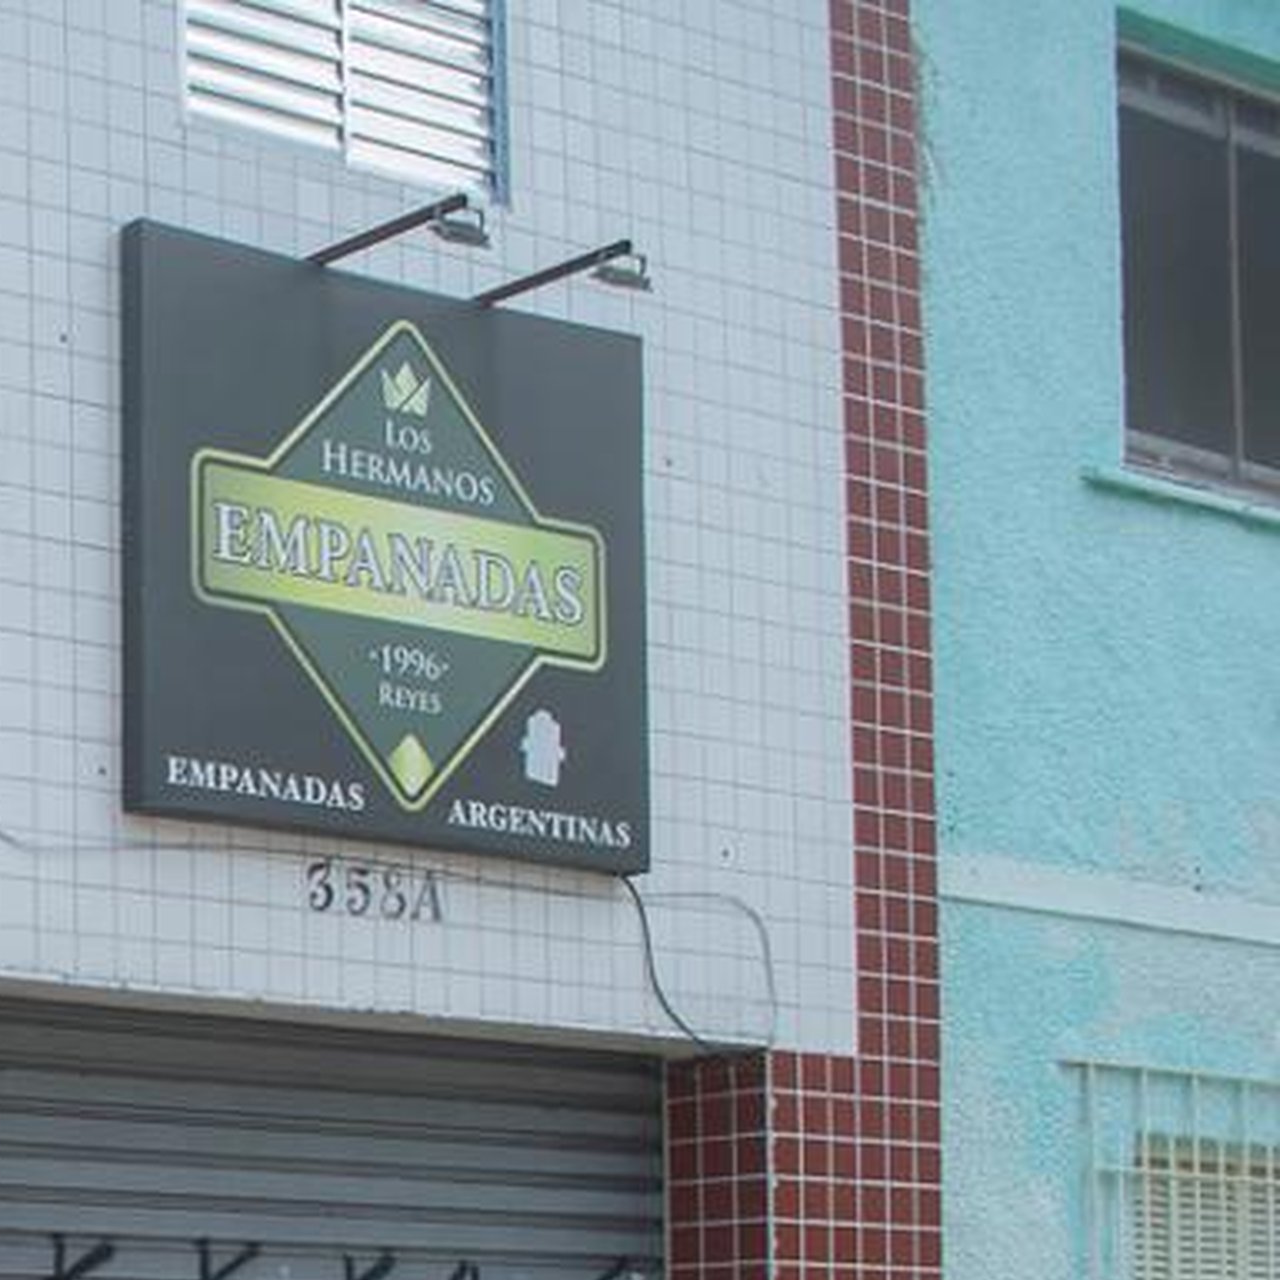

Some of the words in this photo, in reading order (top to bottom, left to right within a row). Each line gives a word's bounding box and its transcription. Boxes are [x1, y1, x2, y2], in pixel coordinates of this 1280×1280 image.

[385, 420, 432, 454] LOS
[321, 440, 496, 506] HERMANOS
[211, 500, 586, 628] EMPANADAS
[379, 681, 443, 715] REYES
[166, 756, 365, 811] EMPANADAS
[447, 797, 631, 849] ARGENTINAS
